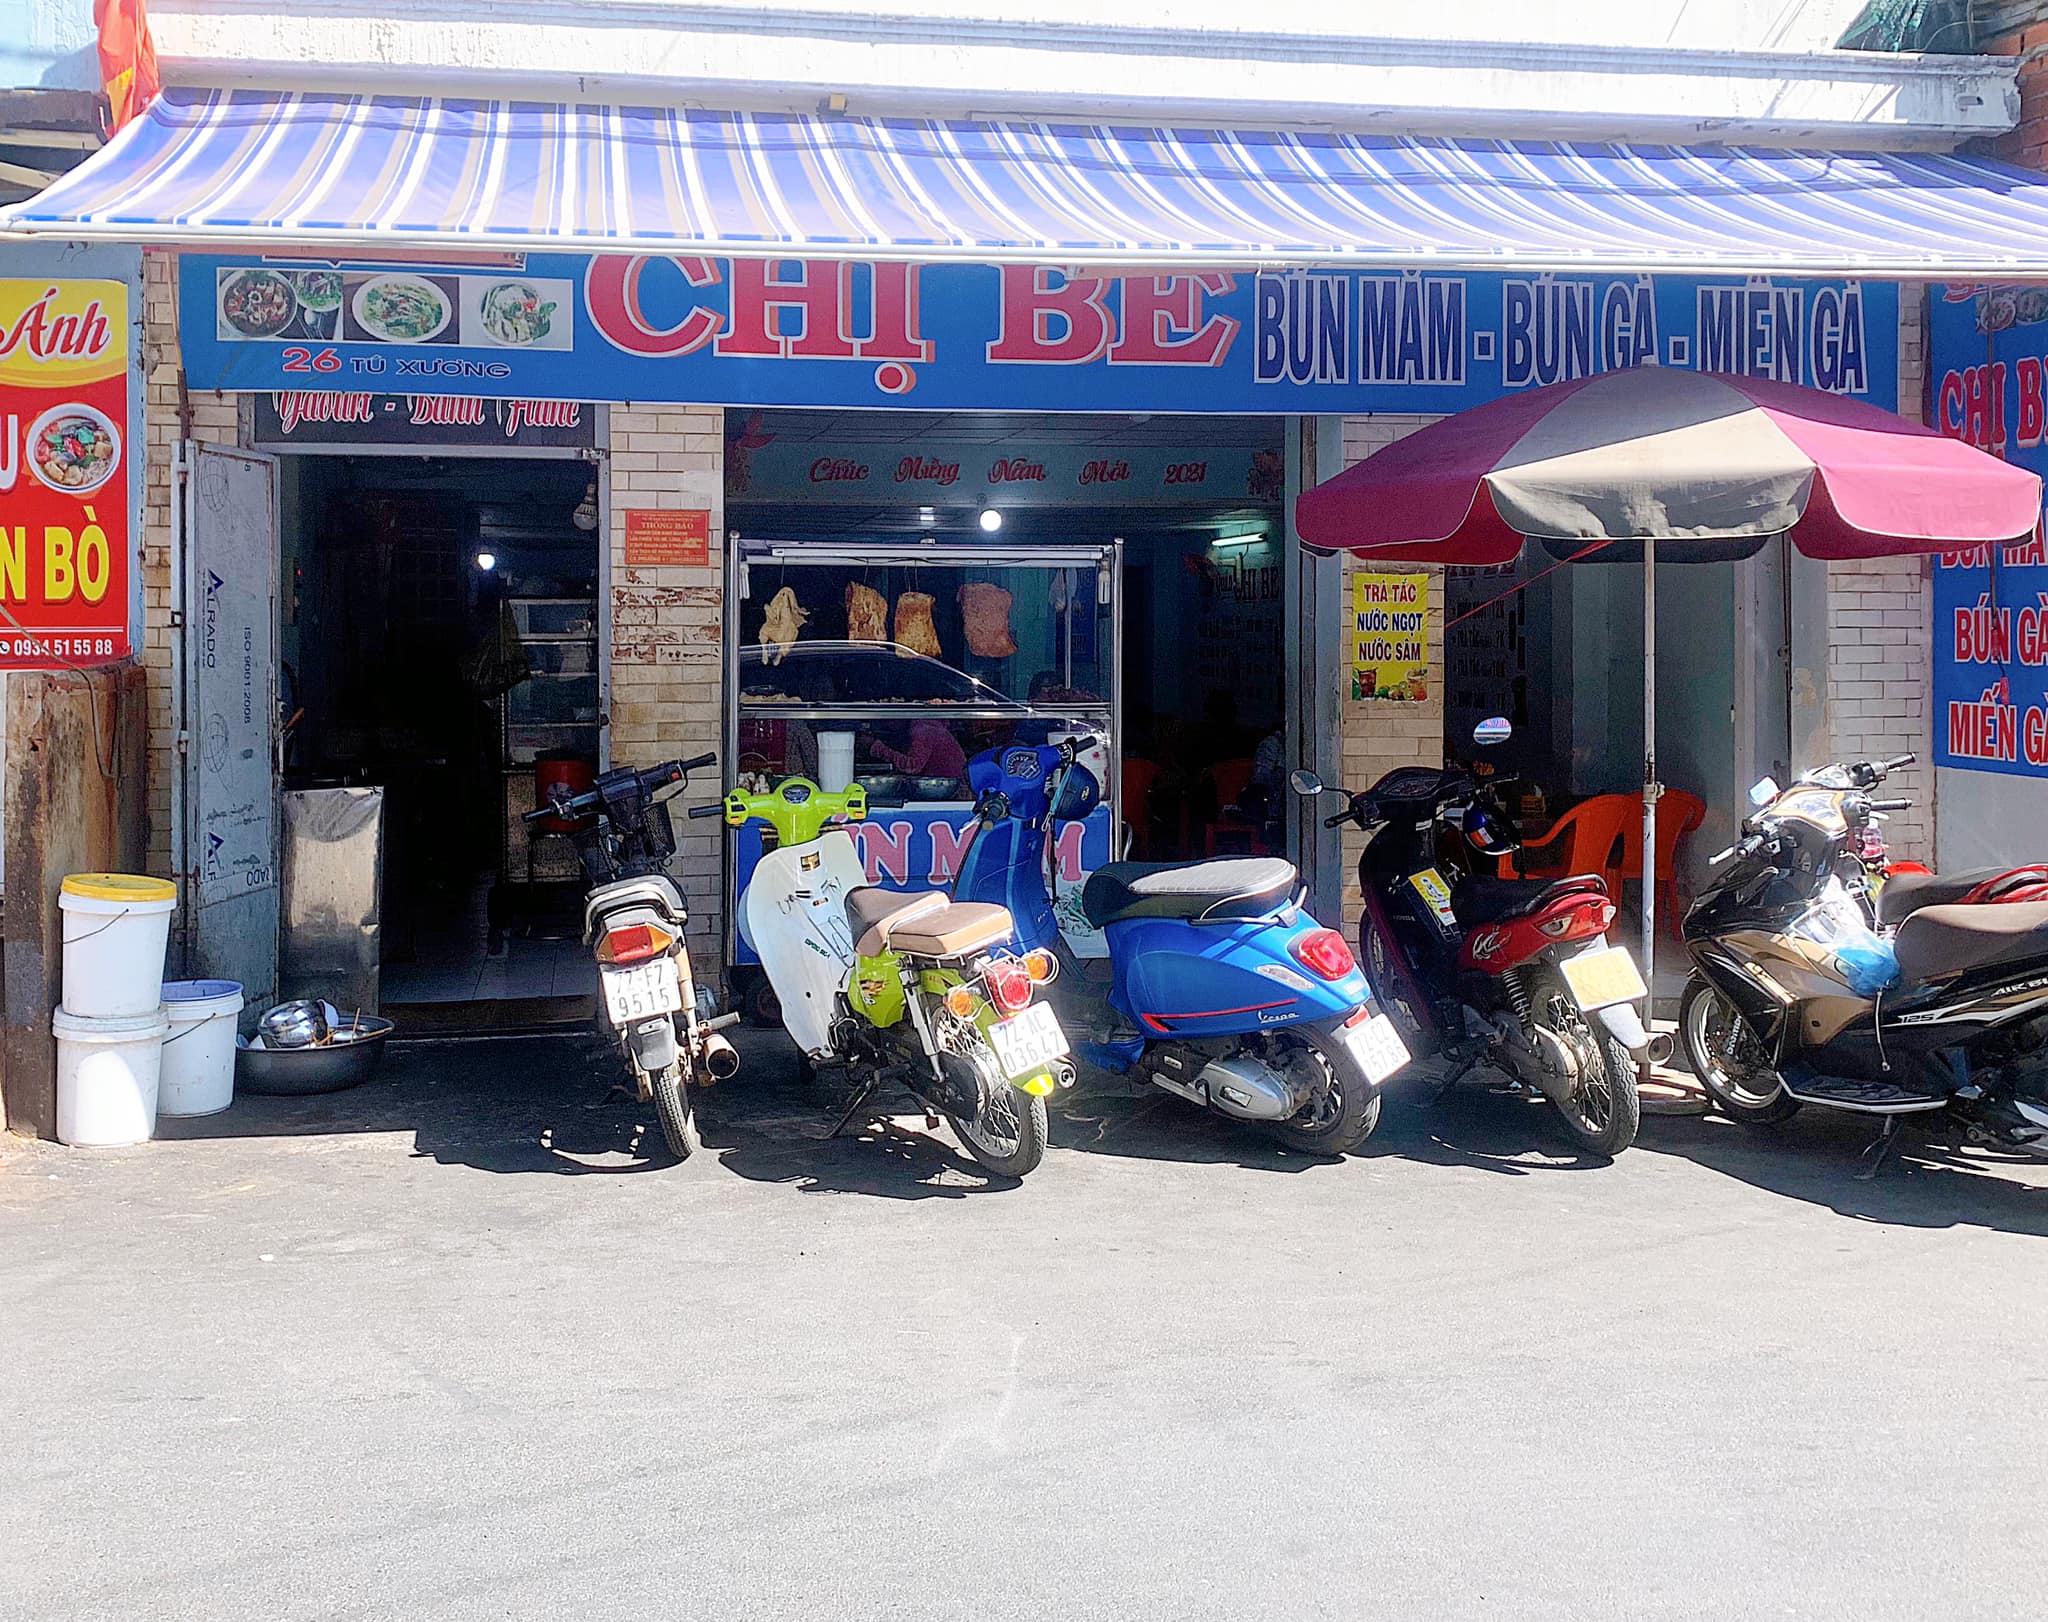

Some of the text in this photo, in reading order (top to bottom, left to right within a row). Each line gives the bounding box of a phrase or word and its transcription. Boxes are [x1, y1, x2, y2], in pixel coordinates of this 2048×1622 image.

[584, 254, 936, 394] CHỊ
[282, 347, 342, 373] 26
[396, 357, 512, 379] XƯƠNG
[44, 505, 110, 601] BÒ
[1363, 577, 1418, 603] TRÀ TẮC
[1356, 607, 1389, 632] NƯỚC
[1391, 612, 1425, 637] NGỌT
[54, 639, 71, 656] 51
[73, 639, 92, 656] 55
[95, 639, 113, 656] 88
[243, 626, 252, 652] ISO
[1358, 636, 1392, 662] NƯỚC
[618, 986, 670, 1018] 9515
[1257, 1010, 1300, 1025] Vespa
